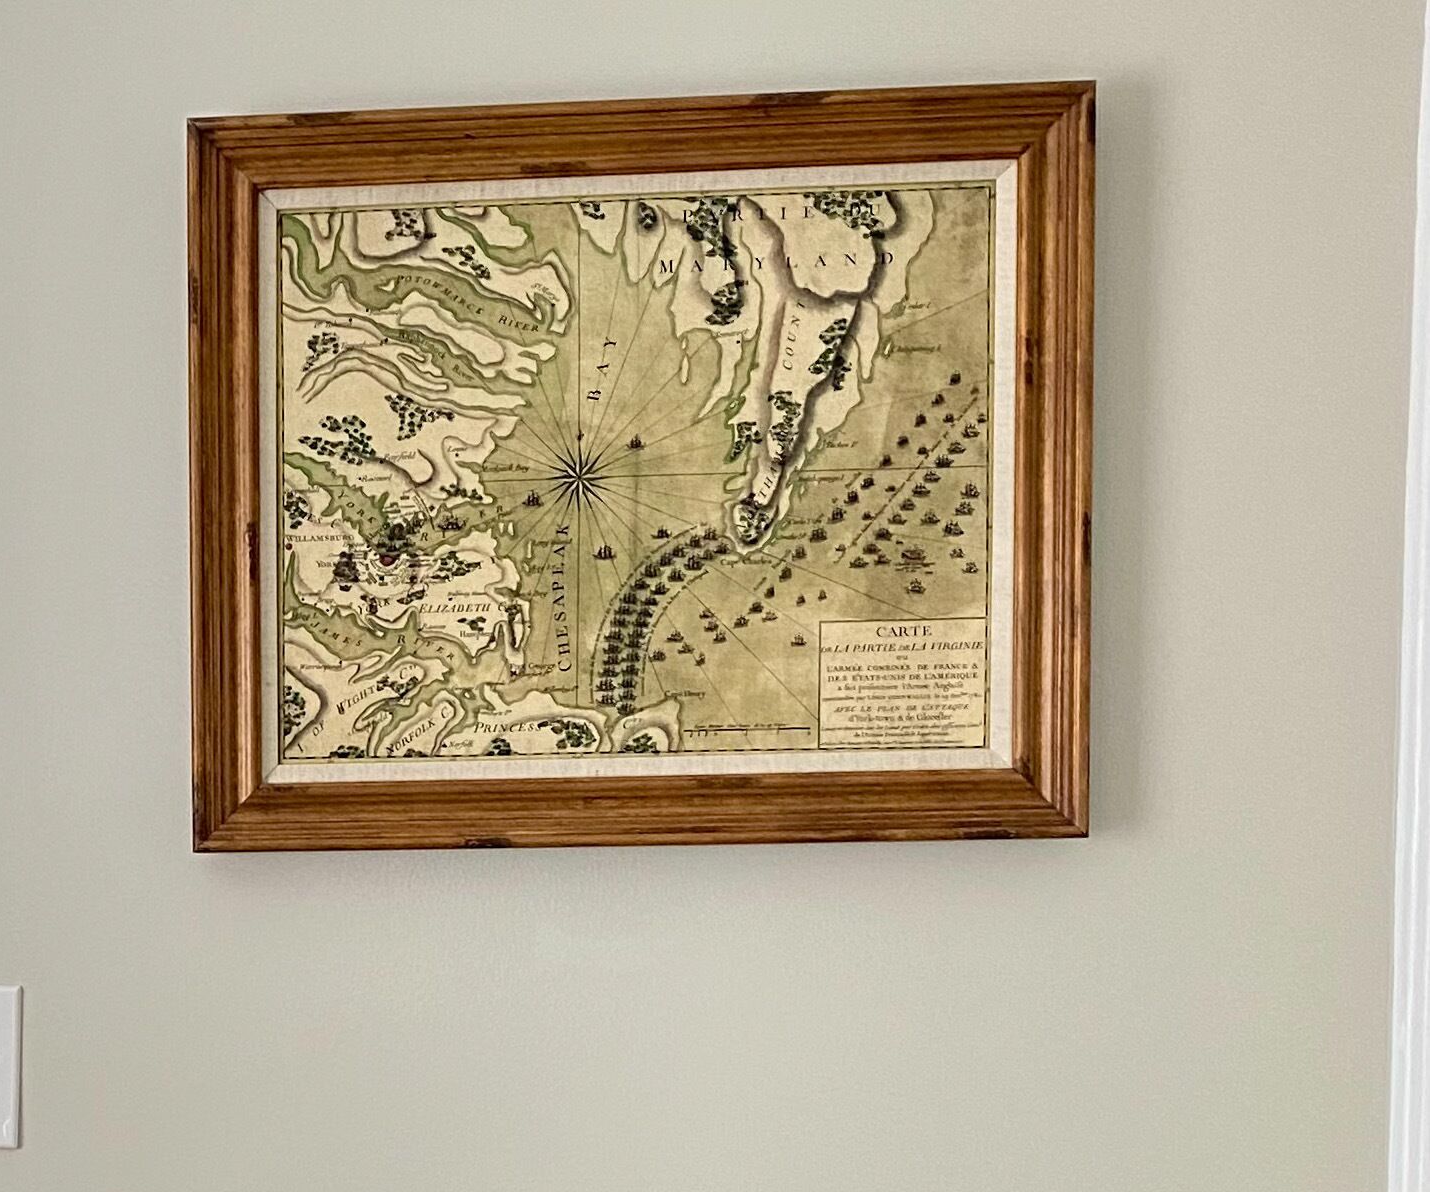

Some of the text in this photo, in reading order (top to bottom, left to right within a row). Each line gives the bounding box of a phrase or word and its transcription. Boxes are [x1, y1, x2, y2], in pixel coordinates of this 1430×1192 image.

[659, 251, 895, 275] MARYLAND
[875, 625, 933, 638] CARTE
[853, 642, 897, 653] PARTIE
[930, 641, 984, 651] VIRGINIE
